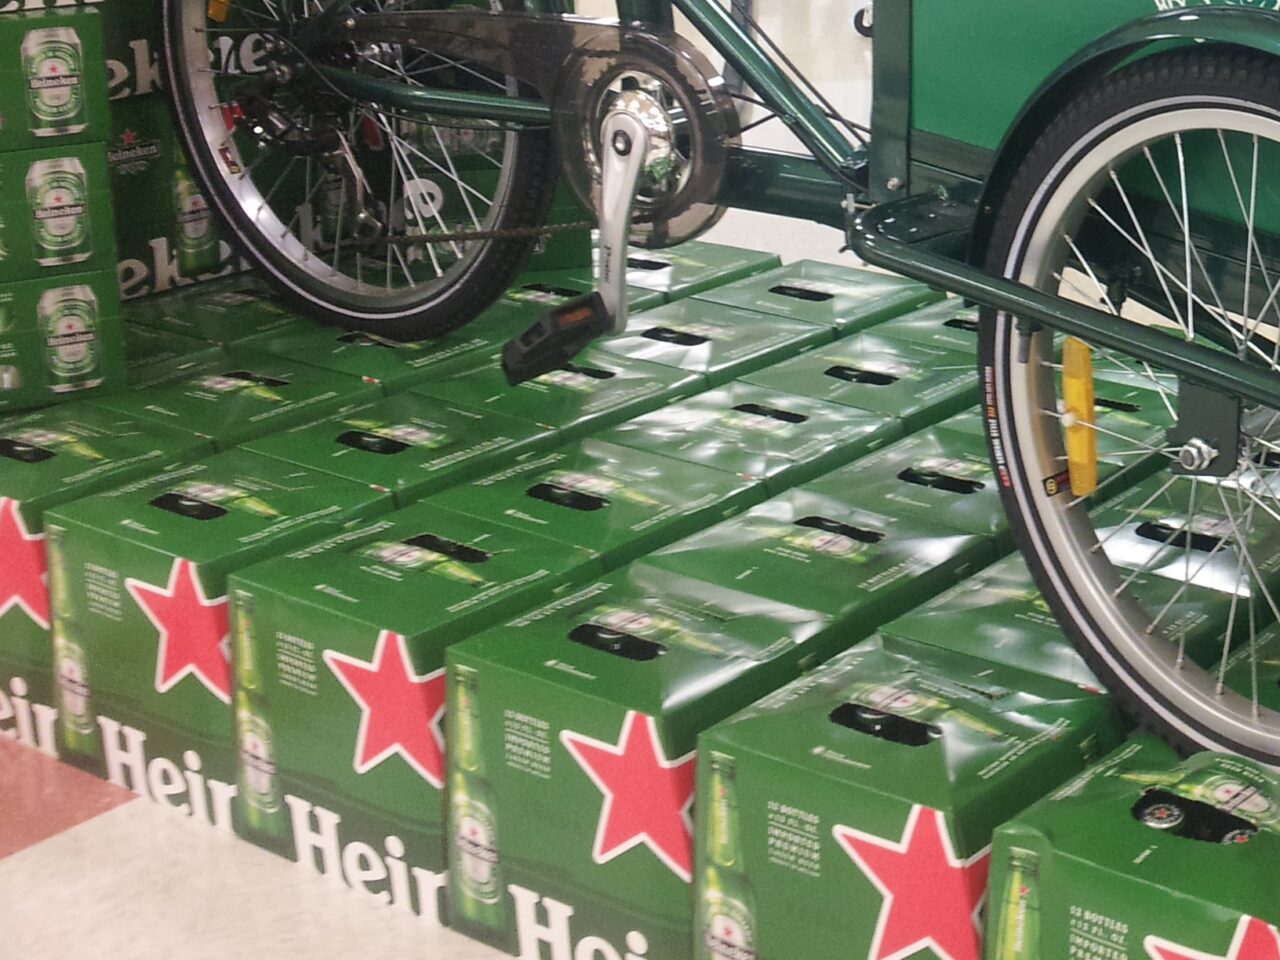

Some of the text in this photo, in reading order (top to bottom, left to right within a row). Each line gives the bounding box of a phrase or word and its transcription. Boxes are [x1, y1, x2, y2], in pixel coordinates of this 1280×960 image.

[29, 75, 80, 89] Heineken
[34, 204, 85, 219] Heineken
[46, 331, 96, 346] Heineken
[1083, 910, 1128, 934] BOTTLES
